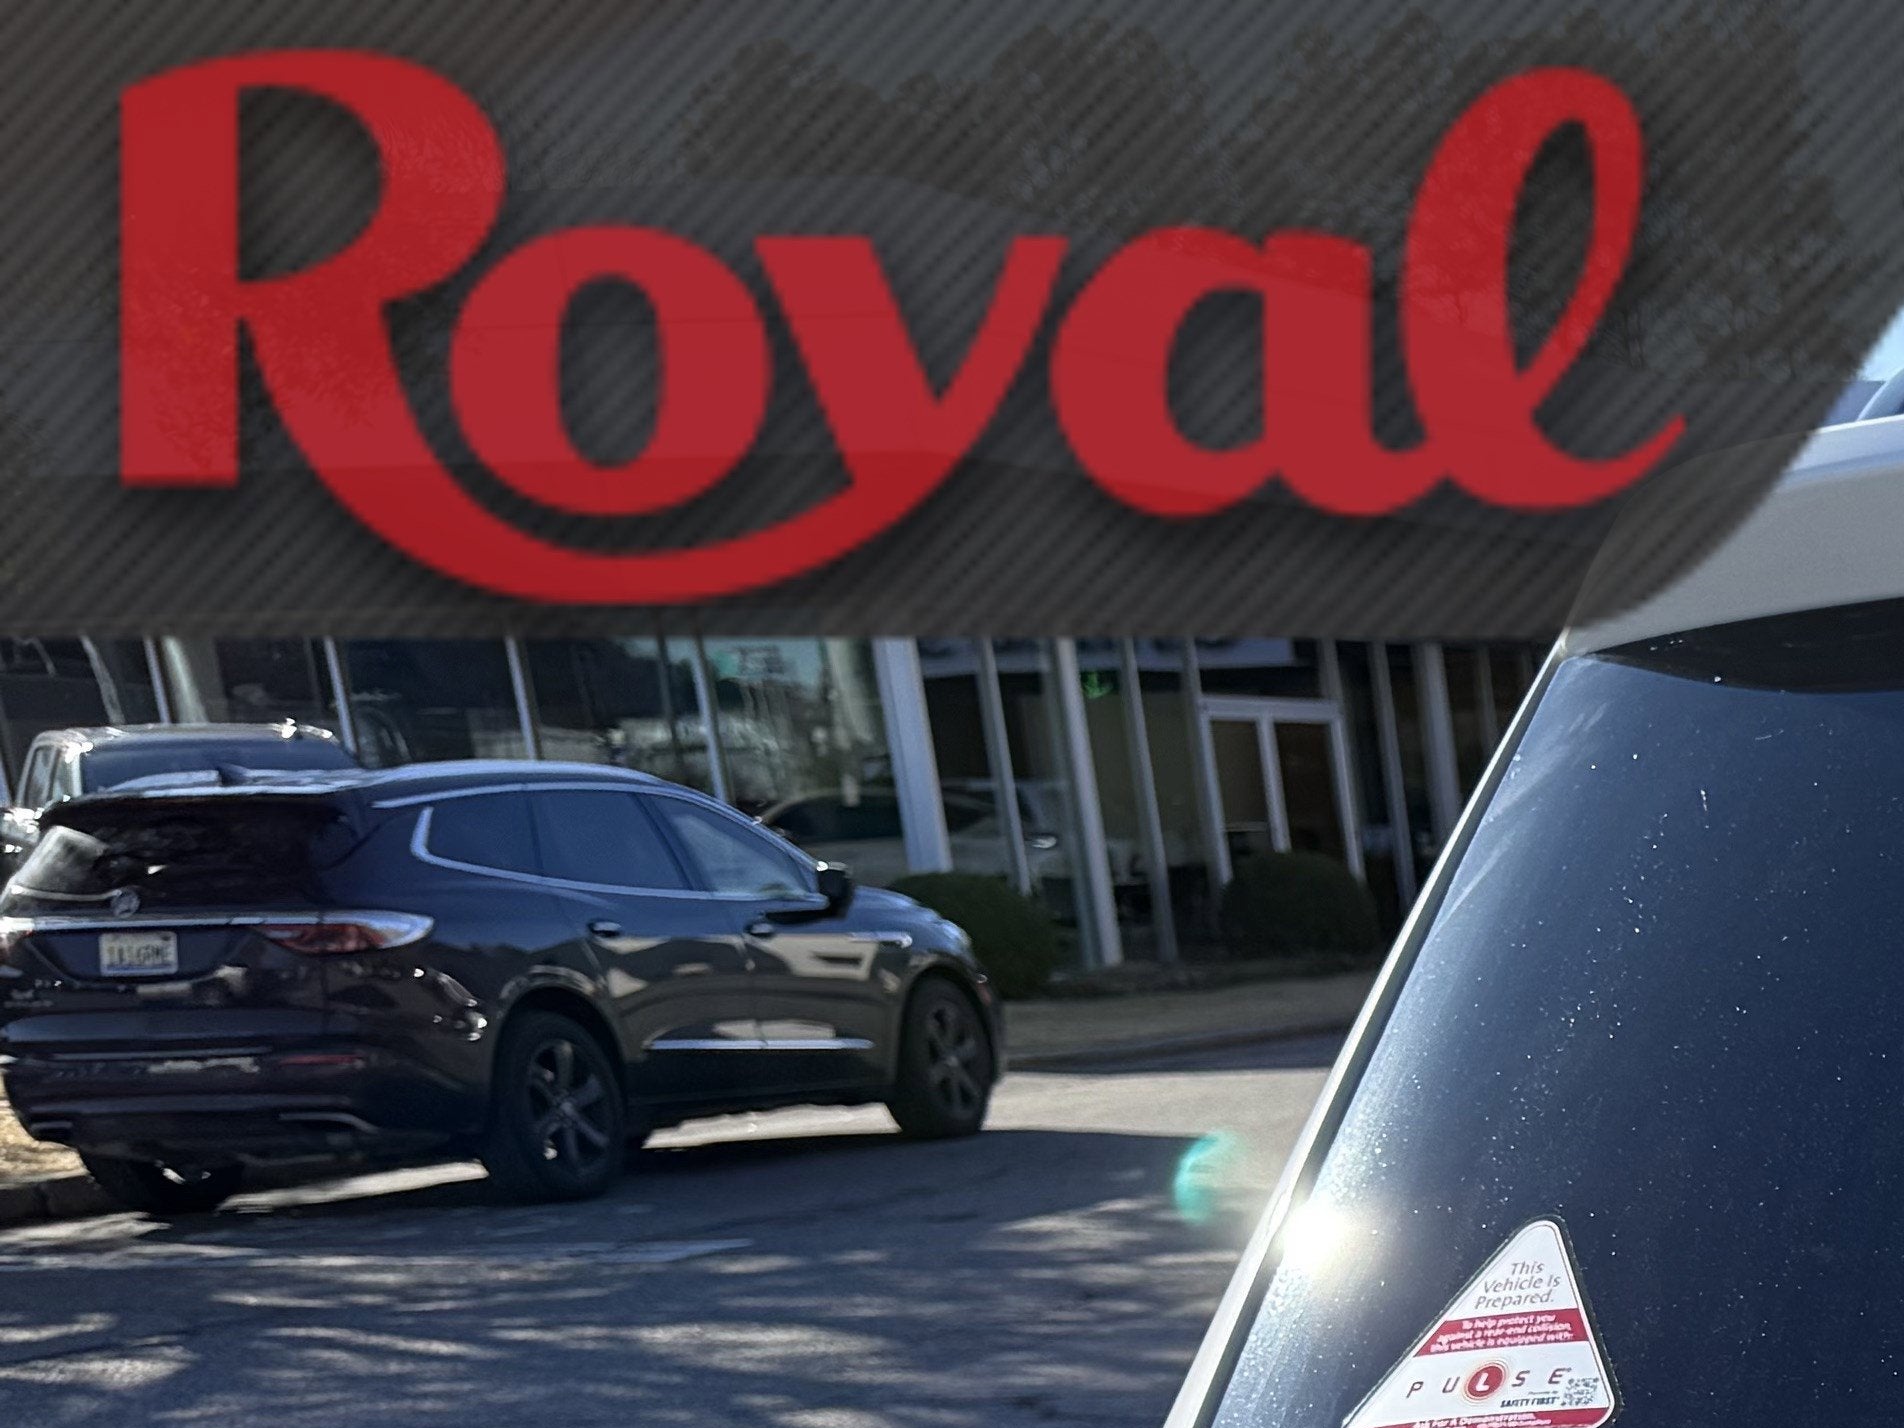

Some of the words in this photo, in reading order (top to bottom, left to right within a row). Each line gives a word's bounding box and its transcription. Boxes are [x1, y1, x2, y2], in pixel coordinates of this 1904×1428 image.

[1511, 1260, 1545, 1276] This
[1484, 1275, 1543, 1293] Vehicle
[1546, 1274, 1561, 1288] Is
[1474, 1289, 1554, 1310] Prepared.
